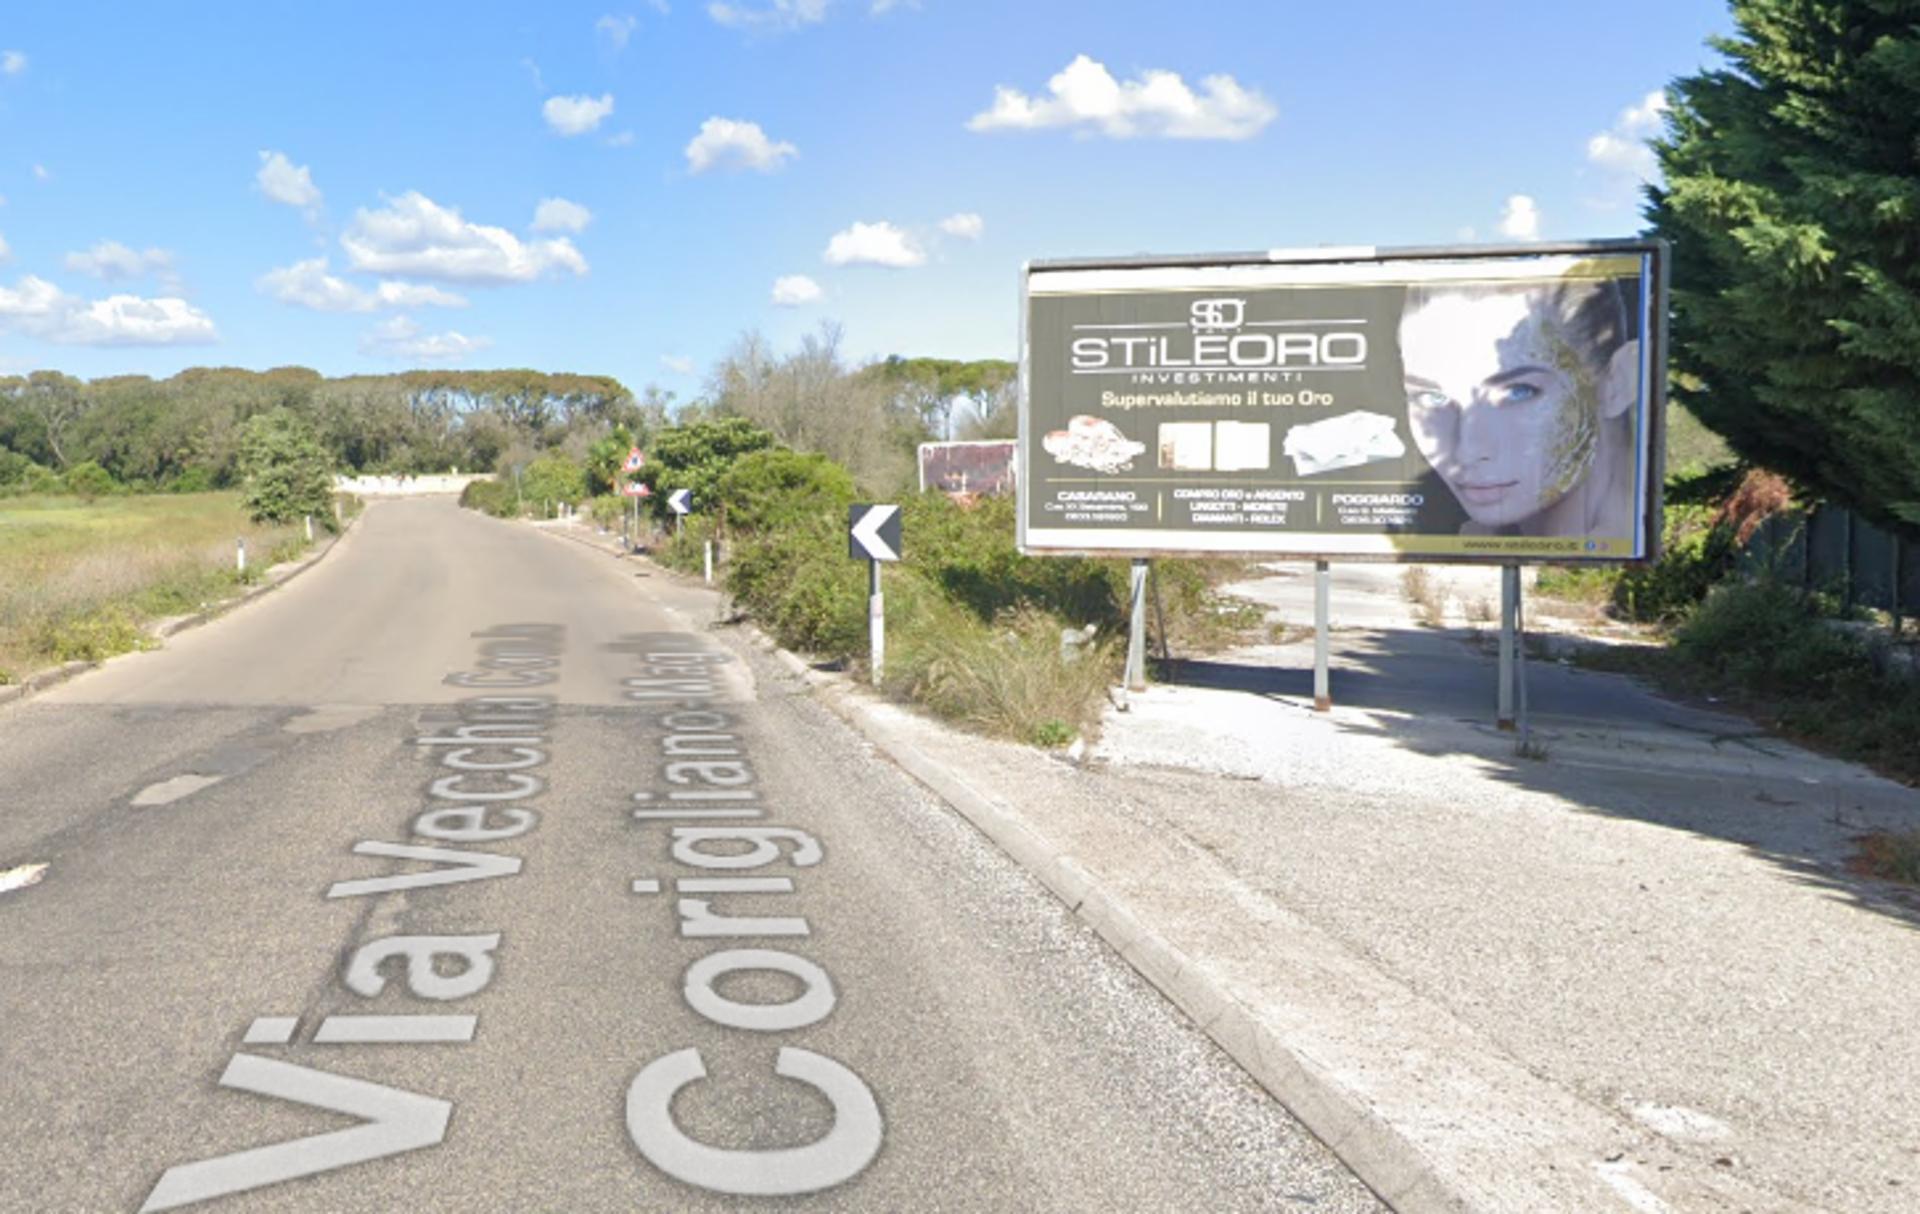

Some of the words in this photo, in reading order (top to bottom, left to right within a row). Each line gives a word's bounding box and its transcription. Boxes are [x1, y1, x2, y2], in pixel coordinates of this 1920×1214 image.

[1131, 372, 1303, 385] INVESTIMENTI
[1101, 391, 1242, 410] Supervalutiamo
[1247, 390, 1258, 406] il
[1262, 391, 1294, 406] tuo
[1298, 390, 1334, 406] Oro
[1332, 493, 1424, 506] POGGIARDO
